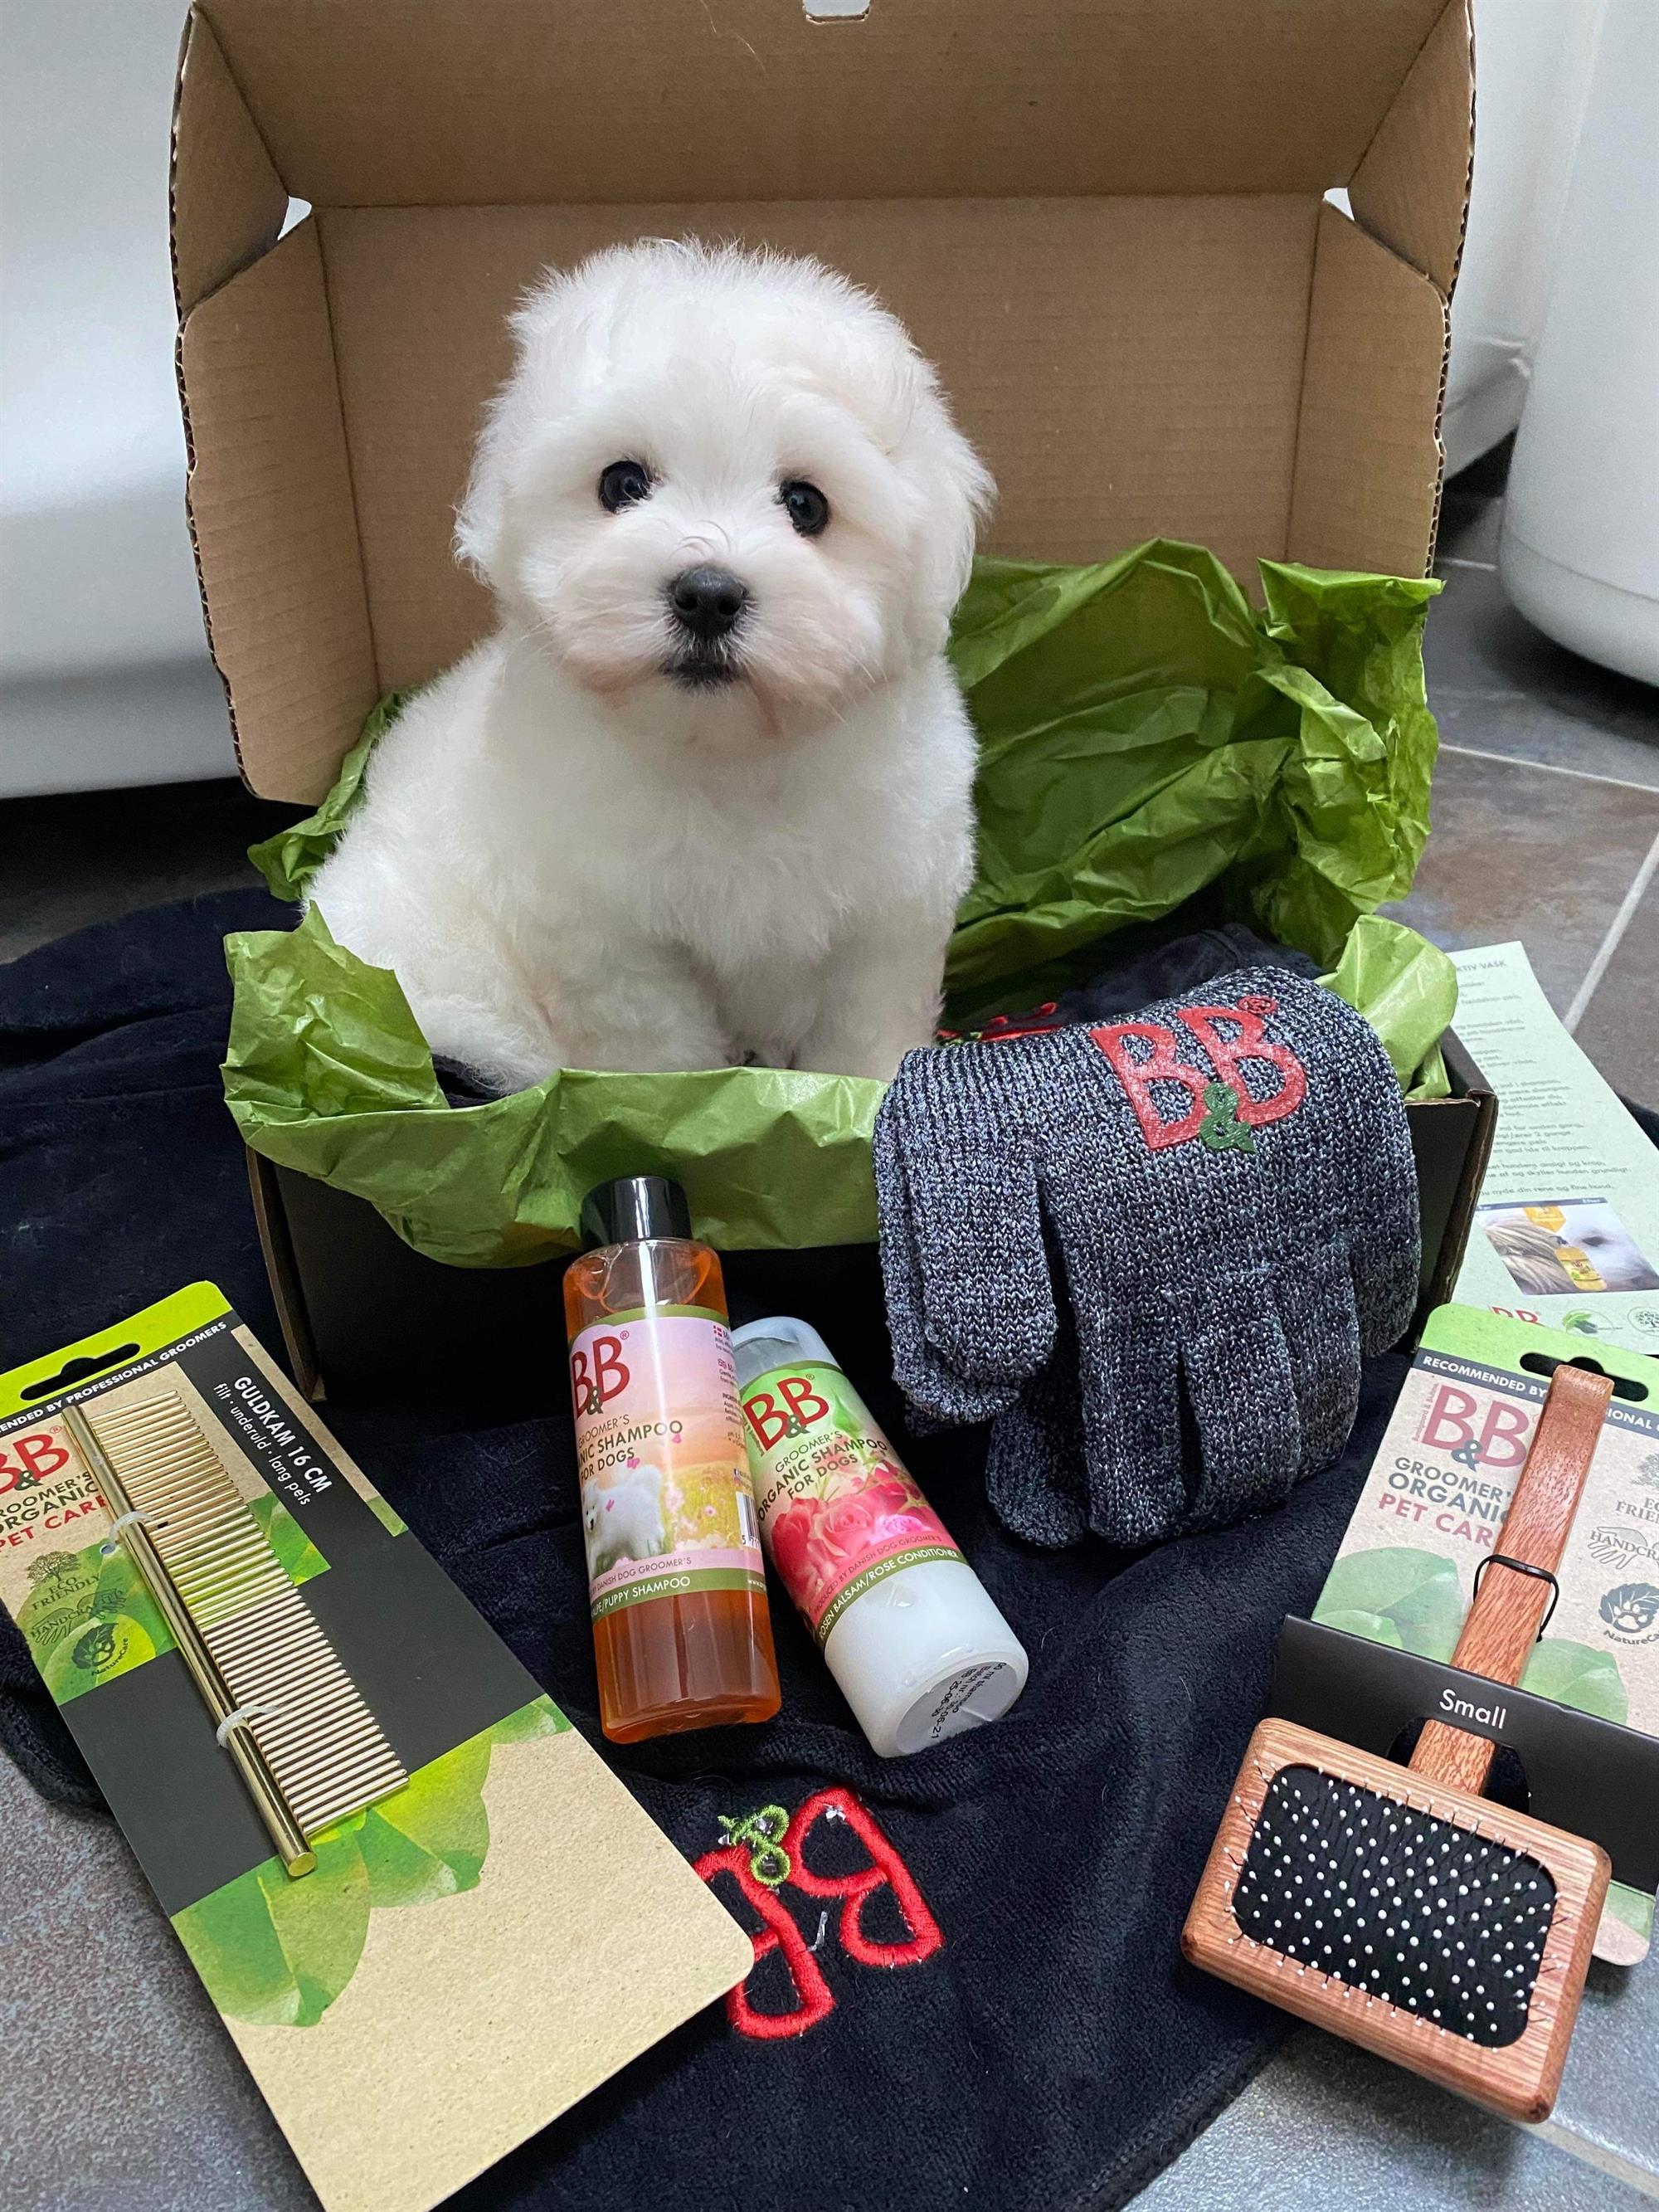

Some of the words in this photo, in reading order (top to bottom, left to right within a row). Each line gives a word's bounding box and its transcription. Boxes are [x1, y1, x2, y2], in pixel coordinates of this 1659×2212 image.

[1480, 960, 1508, 969] VASK
[0, 1410, 43, 1434] ENDED
[46, 1400, 62, 1412] BY
[66, 1359, 158, 1404] PROFESSIONAL
[159, 1322, 226, 1361] GROOMERS
[1422, 1355, 1526, 1392] RECOMMENDED
[1529, 1385, 1548, 1399] BY
[1606, 1407, 1652, 1430] IONAL
[234, 1376, 296, 1447] GULDKAM
[288, 1446, 312, 1467] 16
[304, 1467, 333, 1493] CM
[742, 1377, 830, 1451] B&B
[1419, 1385, 1530, 1472] B&B
[213, 1383, 231, 1400] filt
[230, 1406, 272, 1449] underuld
[268, 1455, 291, 1482] lang
[285, 1482, 312, 1505] pels
[579, 1444, 595, 1468] NIC
[597, 1420, 683, 1454] SHAMPOO
[581, 1464, 595, 1485] FOR
[597, 1447, 635, 1472] DOGS
[0, 1471, 91, 1518] ROOMER'S
[757, 1459, 810, 1522] ORGANIC
[811, 1438, 888, 1464] SHAMPOO
[787, 1474, 815, 1500] FOR
[816, 1454, 859, 1477] DOGS
[1394, 1457, 1511, 1503] GROOMER'
[0, 1481, 99, 1534] RGANIC
[1379, 1493, 1428, 1523] PET
[1435, 1513, 1494, 1547] CAR
[849, 1552, 876, 1574] DANISH
[877, 1542, 898, 1554] DOG
[1589, 1531, 1659, 1562] HANDCR
[32, 1573, 100, 1610] FRIENDLY
[49, 1576, 77, 1594] ECO
[617, 1568, 636, 1581] DOG
[632, 1576, 691, 1597] SHAMPOO
[833, 1559, 897, 1612] BALSAM/ROSE
[897, 1547, 959, 1565] CONDITIONER
[91, 1638, 129, 1676] NatureCare
[1438, 1688, 1506, 1729] Small
